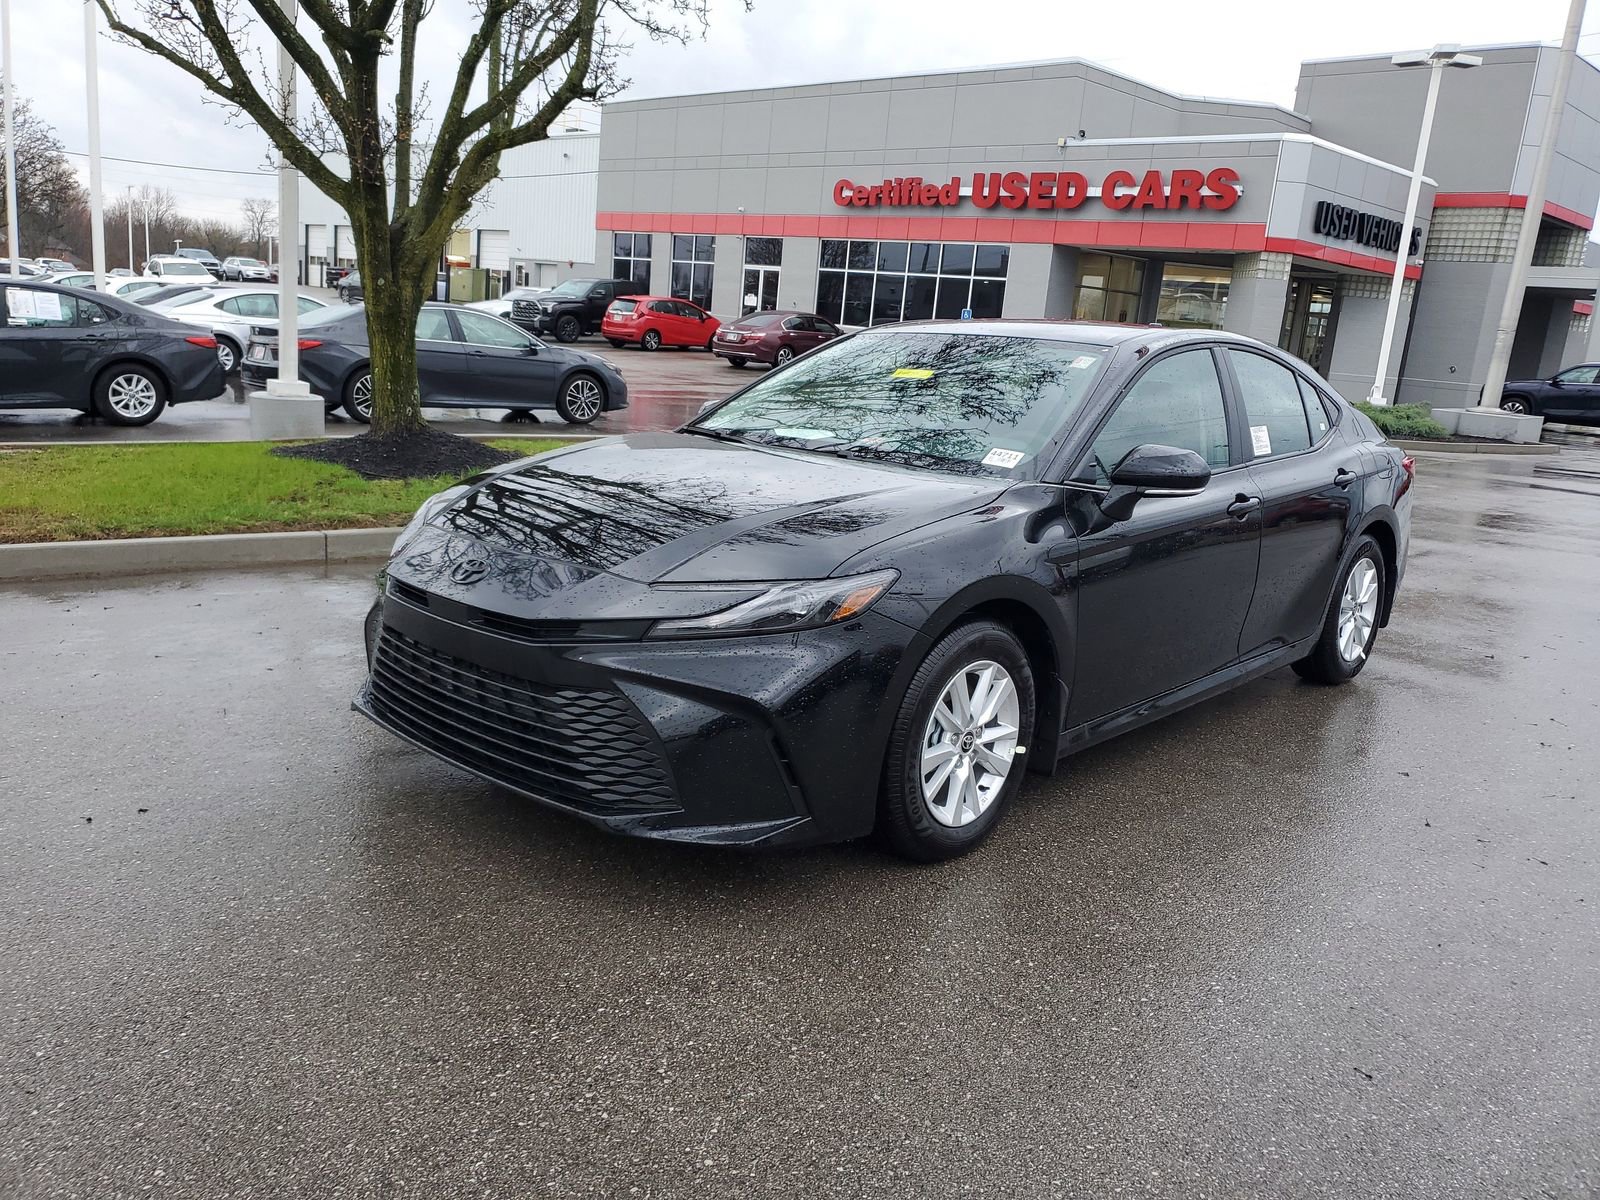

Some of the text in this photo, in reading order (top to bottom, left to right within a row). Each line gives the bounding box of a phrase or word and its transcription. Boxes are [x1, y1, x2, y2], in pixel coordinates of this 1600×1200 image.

[834, 167, 1241, 210] Certified USED CARS
[1315, 201, 1422, 256] USED VEHICS
